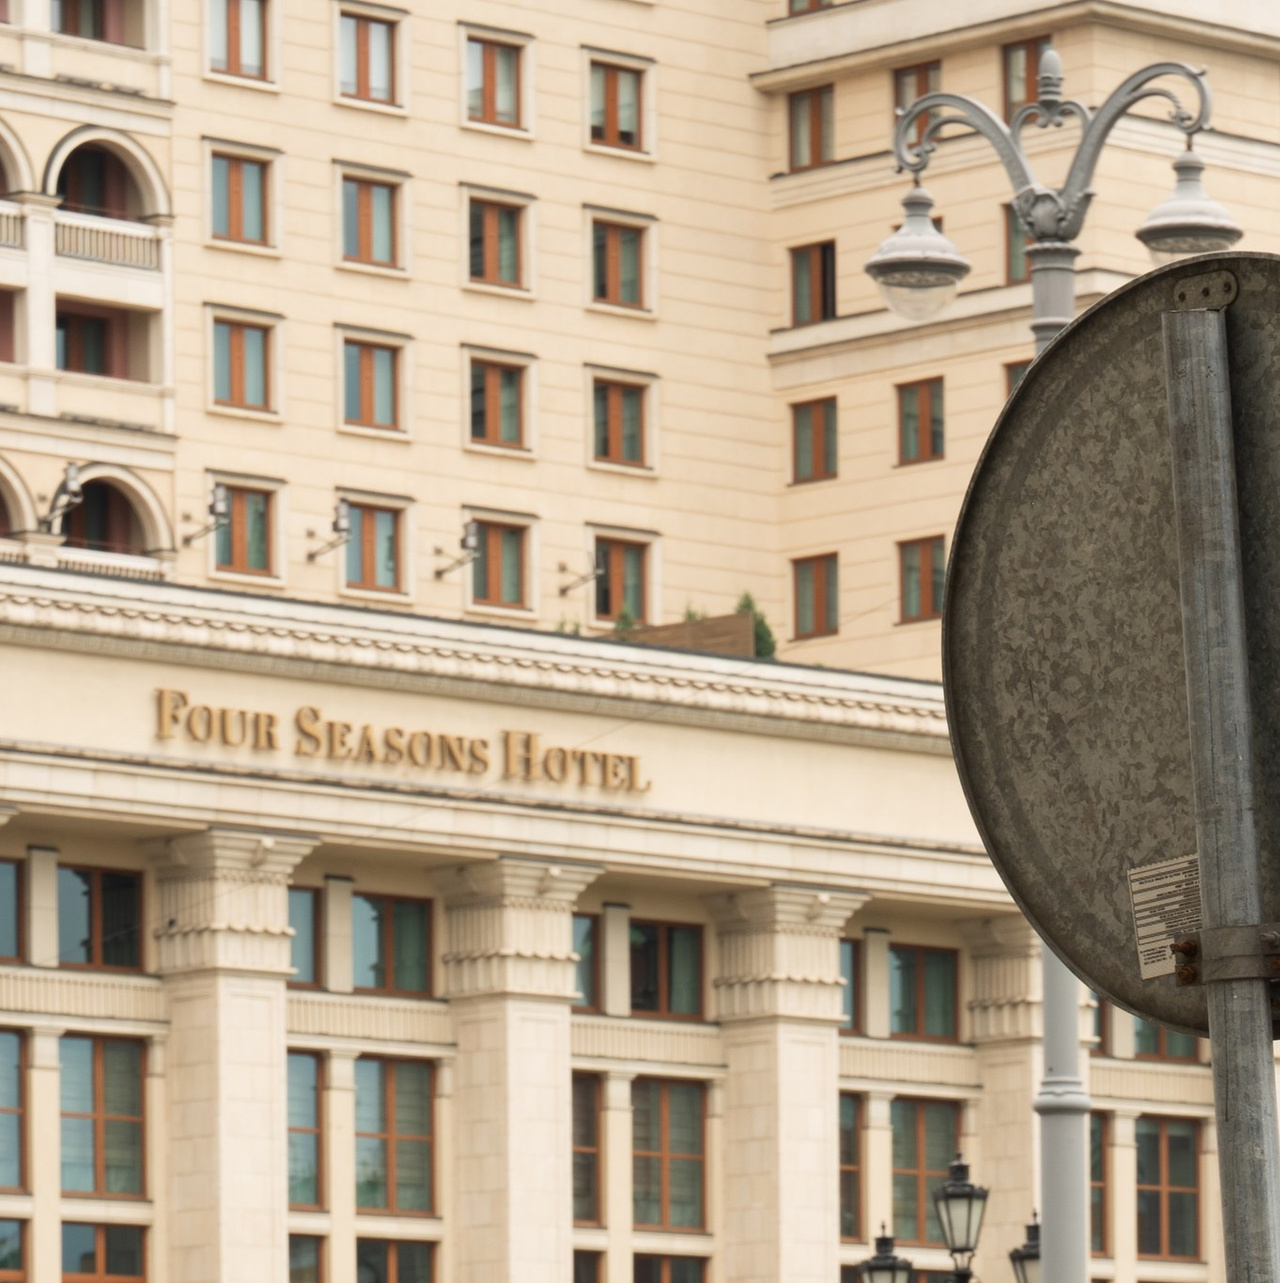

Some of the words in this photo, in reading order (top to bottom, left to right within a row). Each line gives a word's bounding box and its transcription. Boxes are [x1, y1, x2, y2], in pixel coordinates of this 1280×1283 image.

[154, 687, 281, 751] FOUR
[293, 706, 490, 775] SEASONS
[499, 729, 653, 795] HOTEL
